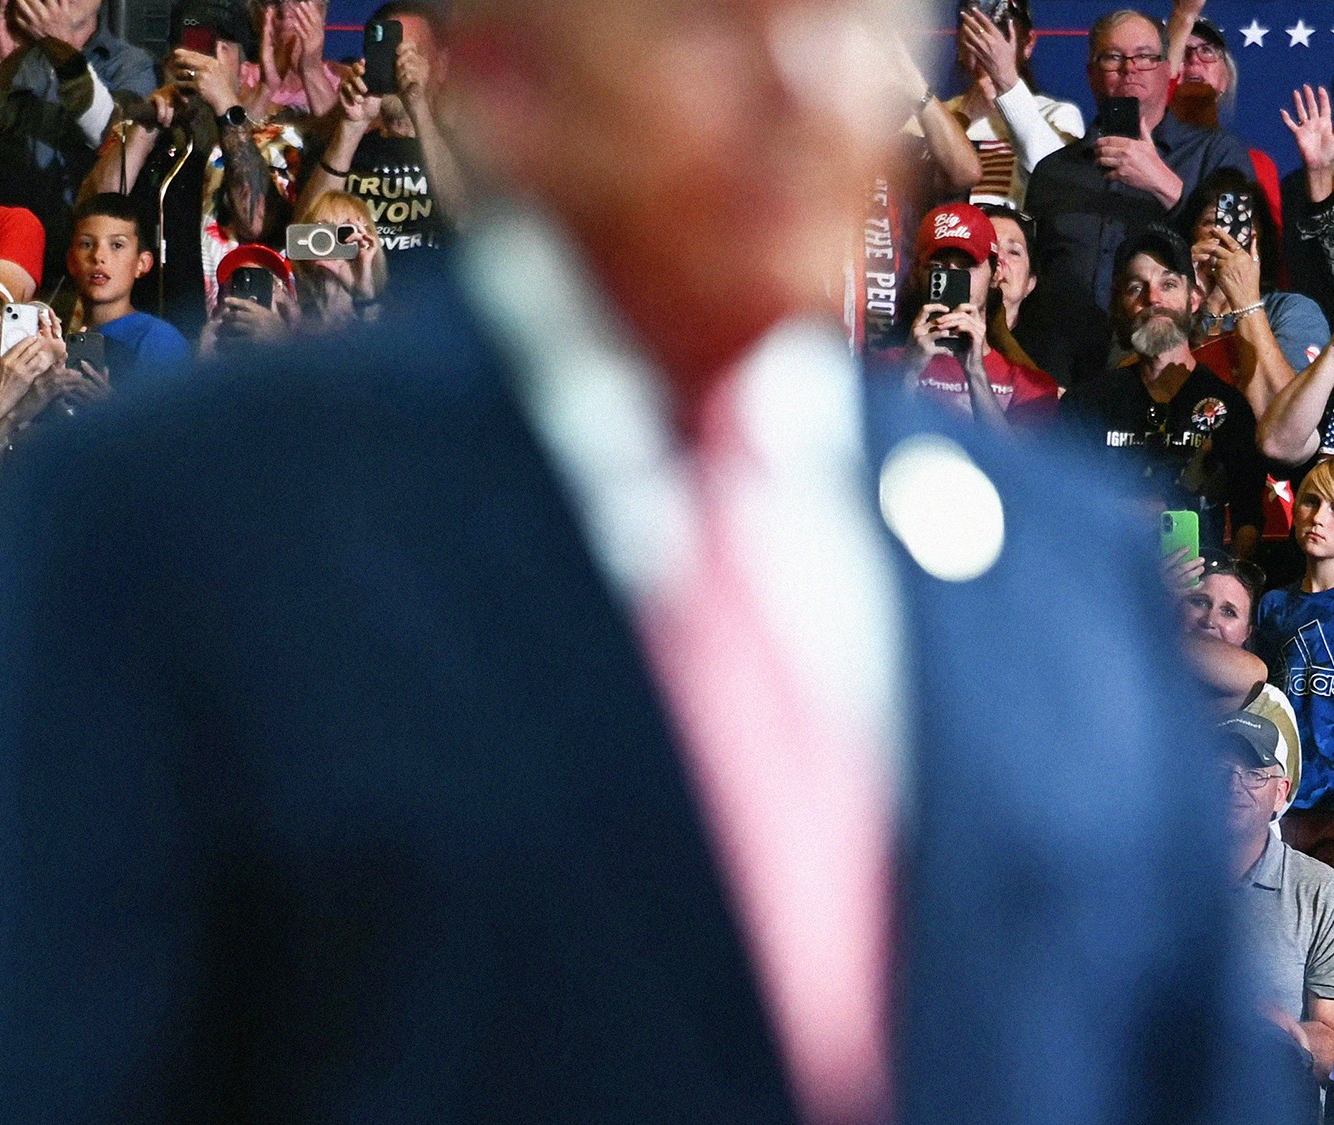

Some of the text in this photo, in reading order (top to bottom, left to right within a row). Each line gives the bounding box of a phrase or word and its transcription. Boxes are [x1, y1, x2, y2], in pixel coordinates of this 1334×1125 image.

[348, 174, 428, 199] TRUM
[934, 213, 960, 228] Big
[376, 225, 402, 235] 2024
[934, 225, 971, 240] Balls
[865, 217, 894, 261] THE
